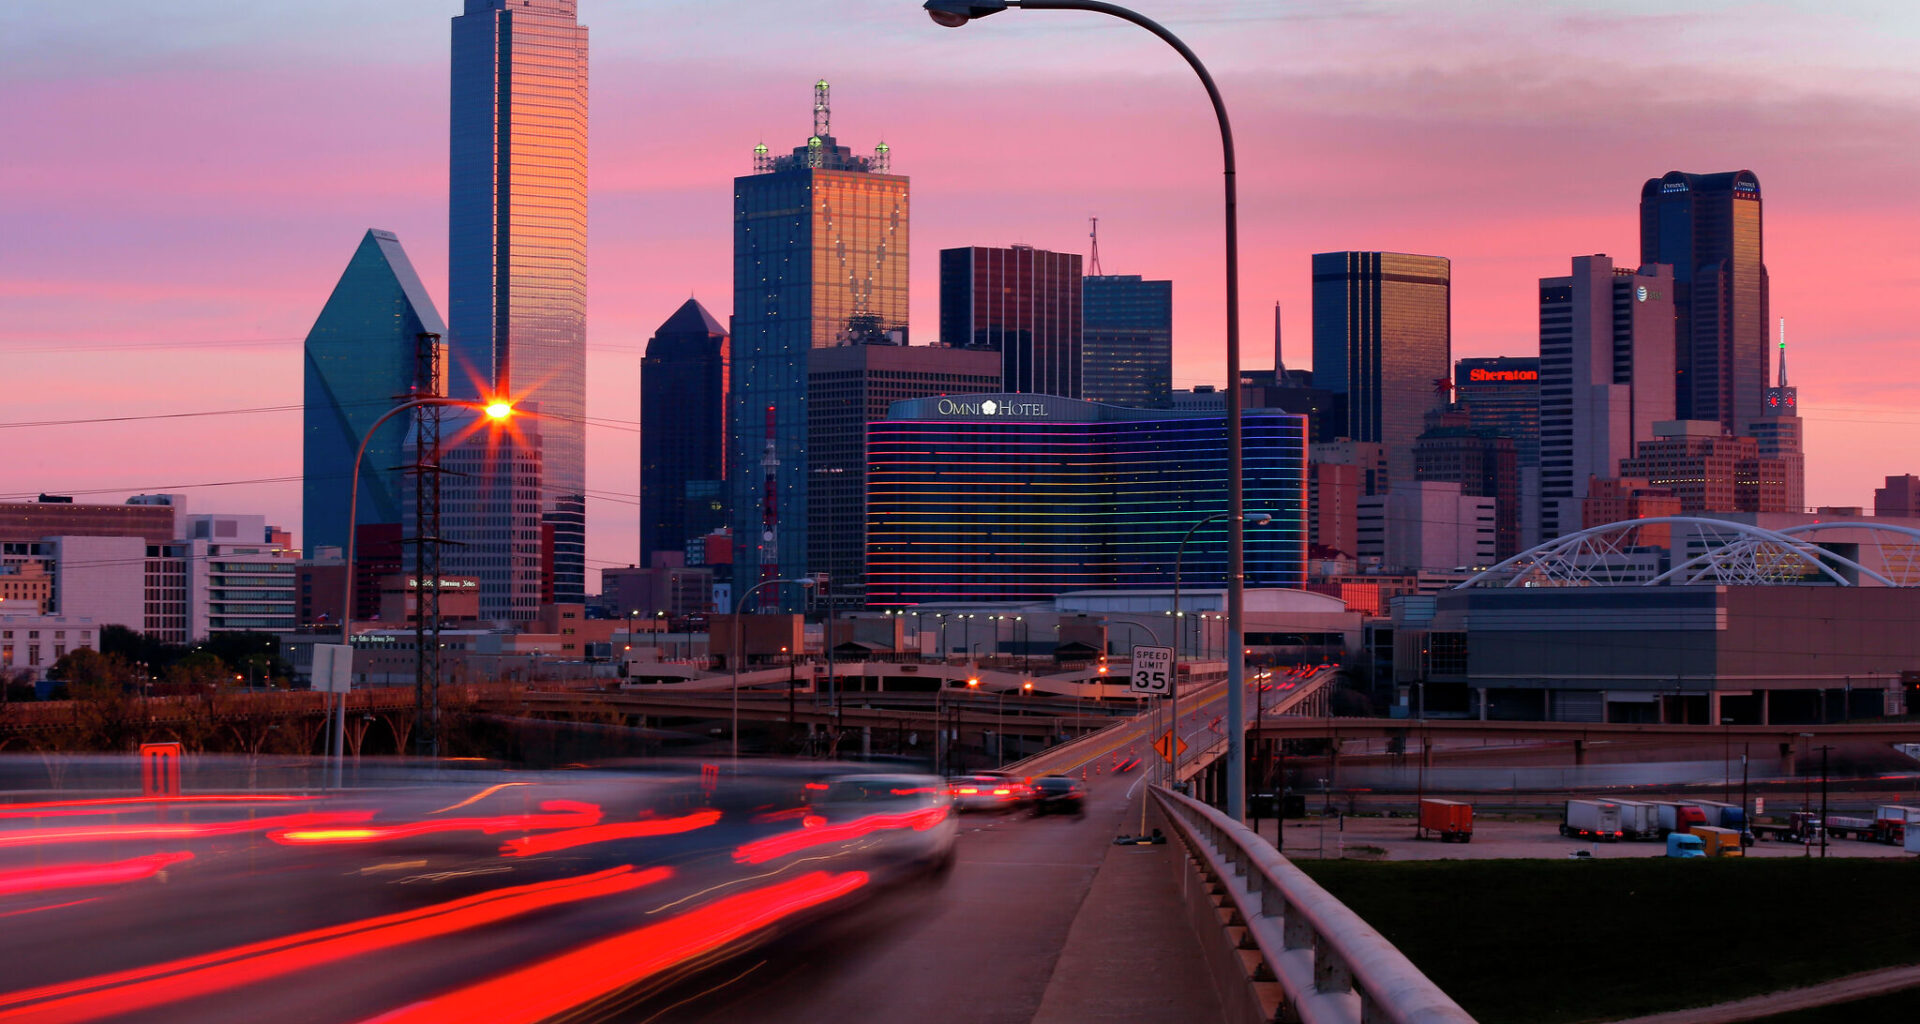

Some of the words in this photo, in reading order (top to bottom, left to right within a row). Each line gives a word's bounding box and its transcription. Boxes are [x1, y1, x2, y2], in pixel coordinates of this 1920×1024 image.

[1470, 368, 1538, 381] Sheraton
[938, 399, 980, 415] OMNI
[998, 400, 1049, 416] HOTEL
[1136, 651, 1168, 660] SPEED
[1139, 661, 1164, 669] LIMIT
[1135, 670, 1166, 690] 35
